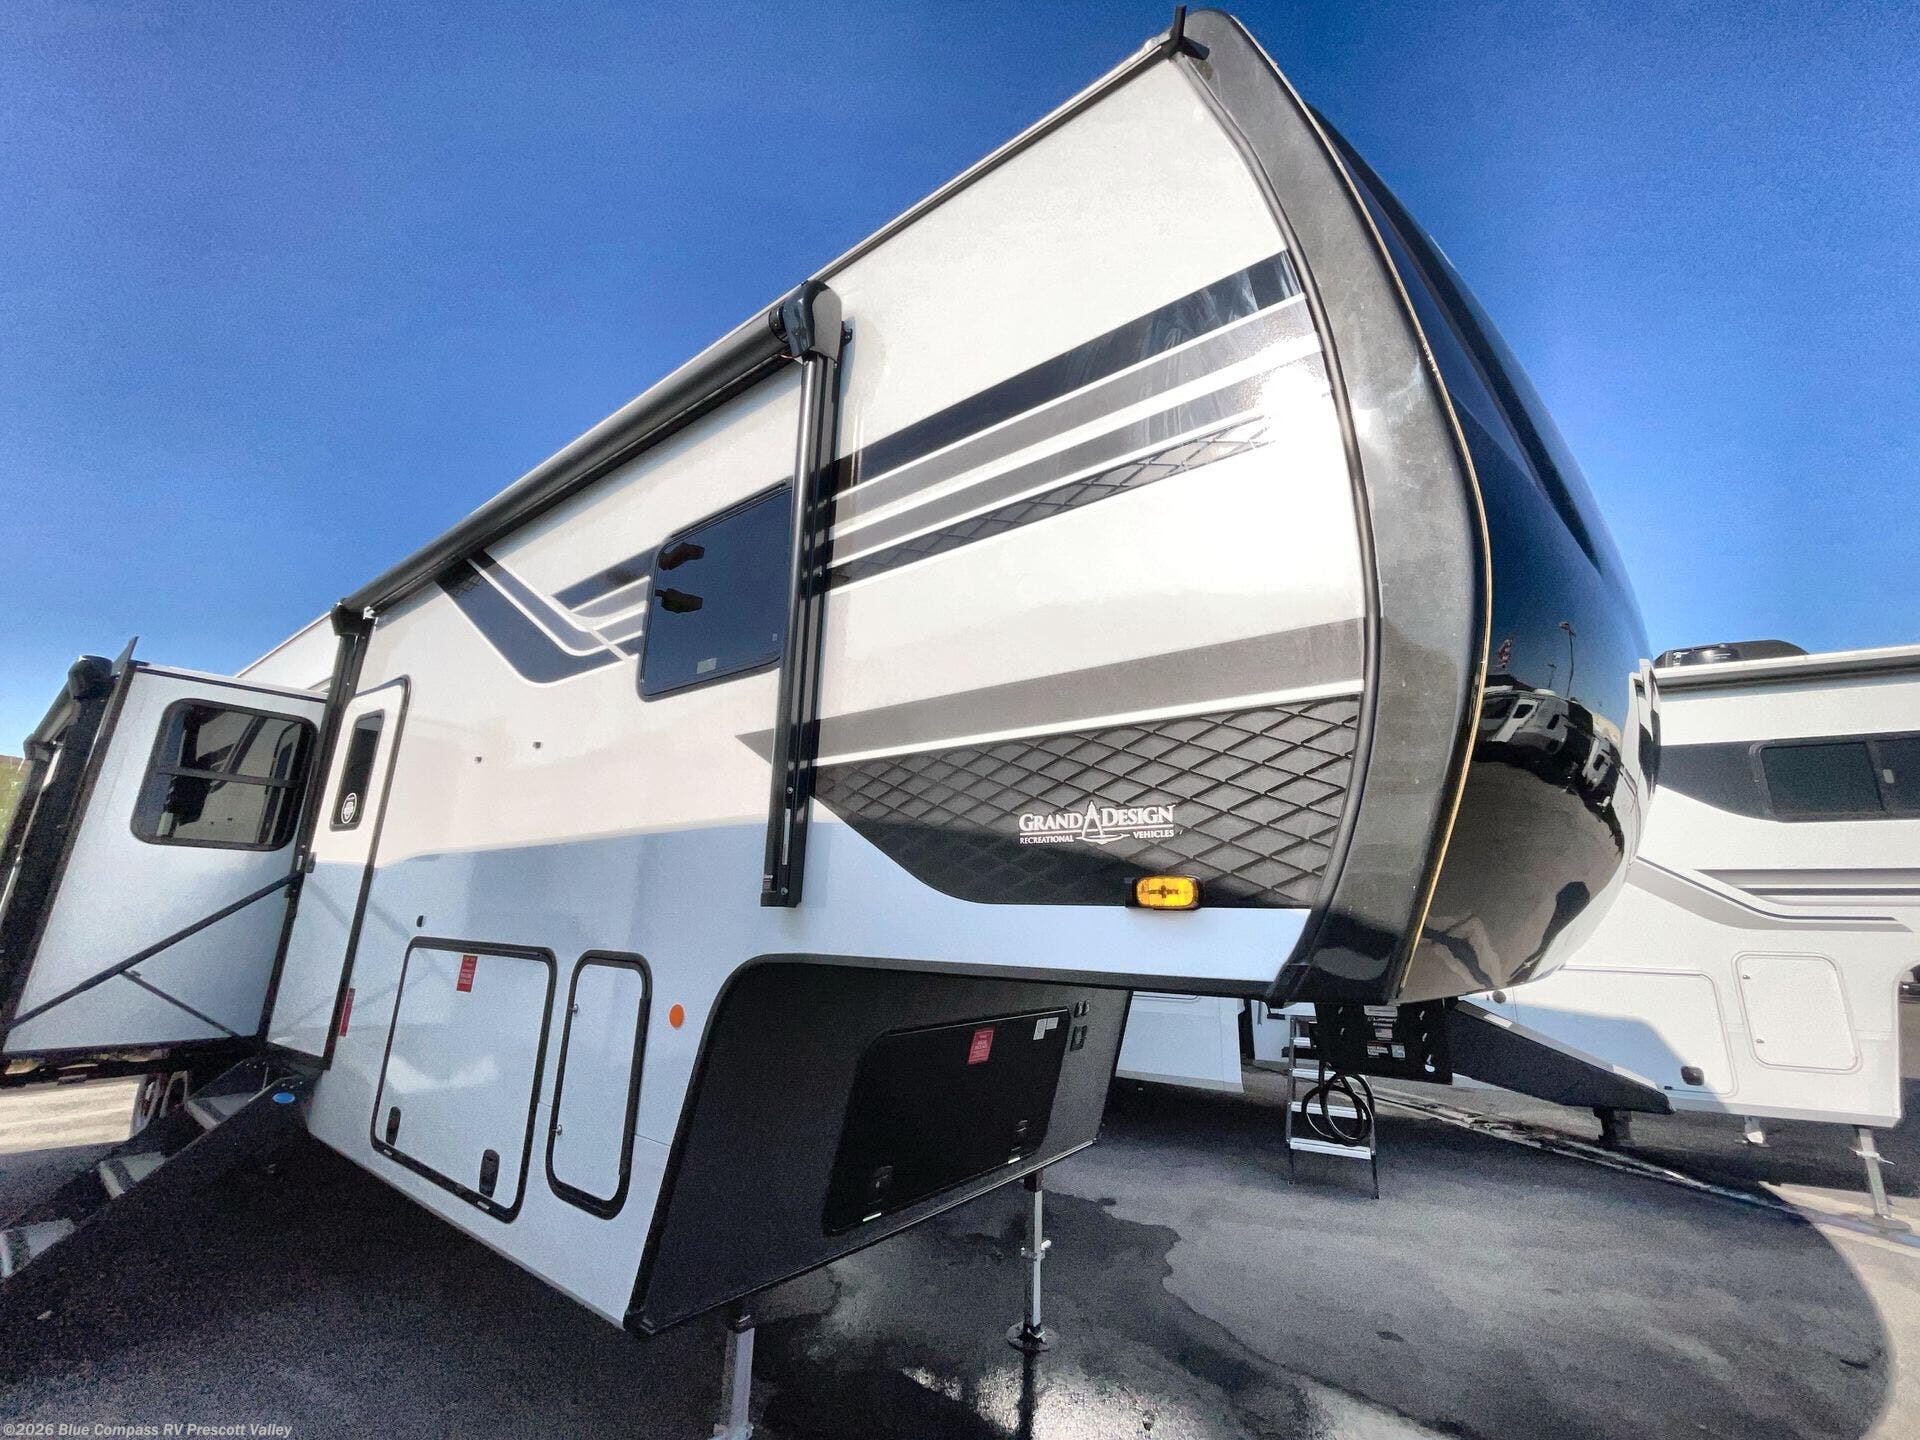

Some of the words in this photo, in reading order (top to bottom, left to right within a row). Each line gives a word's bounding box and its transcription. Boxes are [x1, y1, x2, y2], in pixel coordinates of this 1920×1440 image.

[1019, 813, 1083, 831] GRAND
[1100, 804, 1176, 827] DESIGN
[1020, 835, 1075, 845] RECREATIONAL
[1133, 829, 1174, 839] VEHICLES
